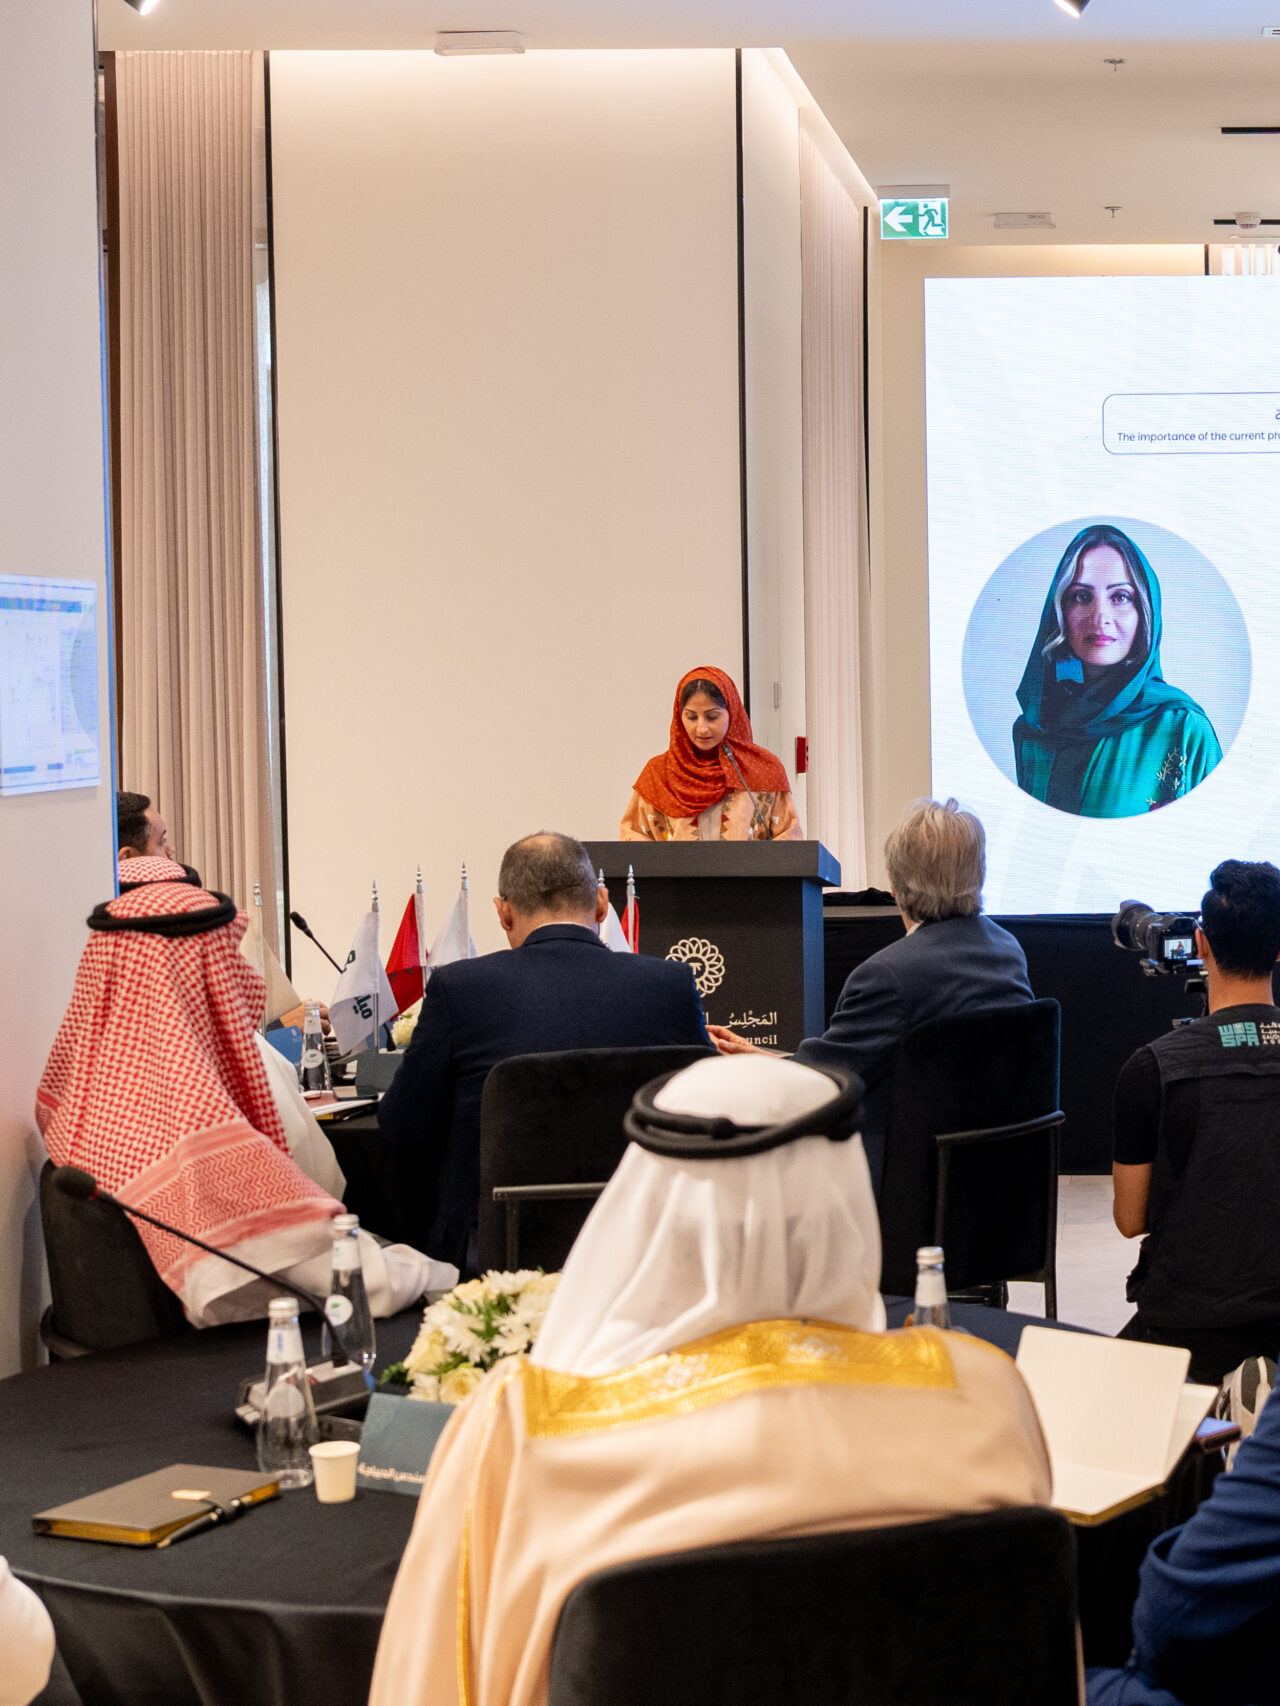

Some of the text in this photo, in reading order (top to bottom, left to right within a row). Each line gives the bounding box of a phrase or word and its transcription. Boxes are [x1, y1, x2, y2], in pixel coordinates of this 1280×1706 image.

[1117, 432, 1135, 442] The
[1138, 432, 1196, 444] importance
[1198, 432, 1209, 442] of
[1211, 432, 1227, 442] the
[1229, 432, 1265, 441] current
[744, 1034, 778, 1045] uncil
[1221, 1035, 1260, 1047] SPA
